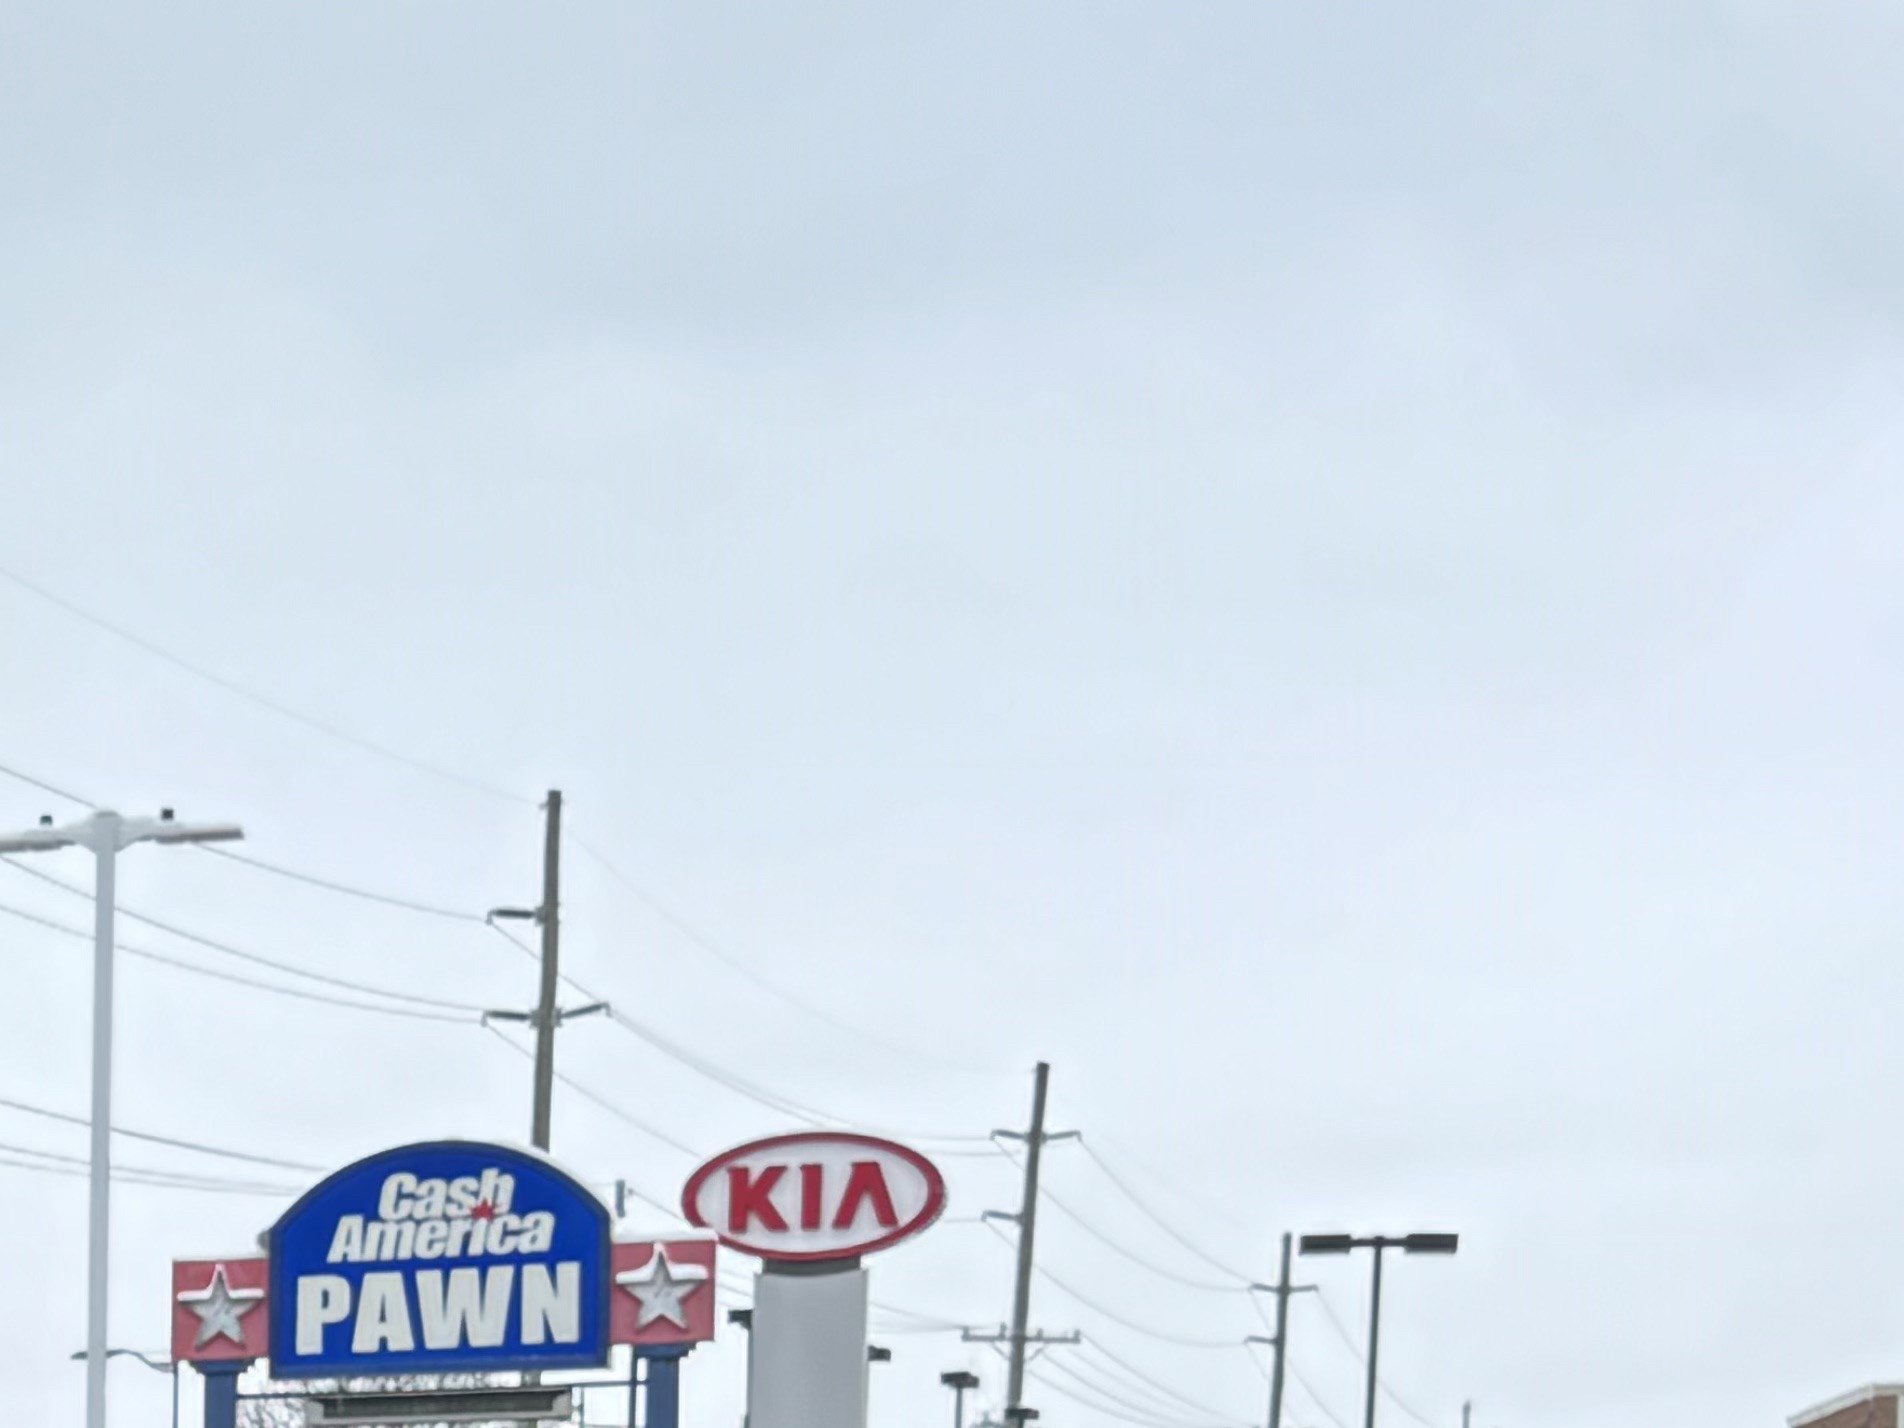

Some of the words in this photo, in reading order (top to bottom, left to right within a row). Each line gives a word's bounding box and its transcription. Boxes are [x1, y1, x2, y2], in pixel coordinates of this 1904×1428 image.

[378, 1168, 515, 1220] Cash
[727, 1161, 899, 1235] KIA
[326, 1210, 556, 1264] America
[295, 1260, 581, 1356] PAWN
